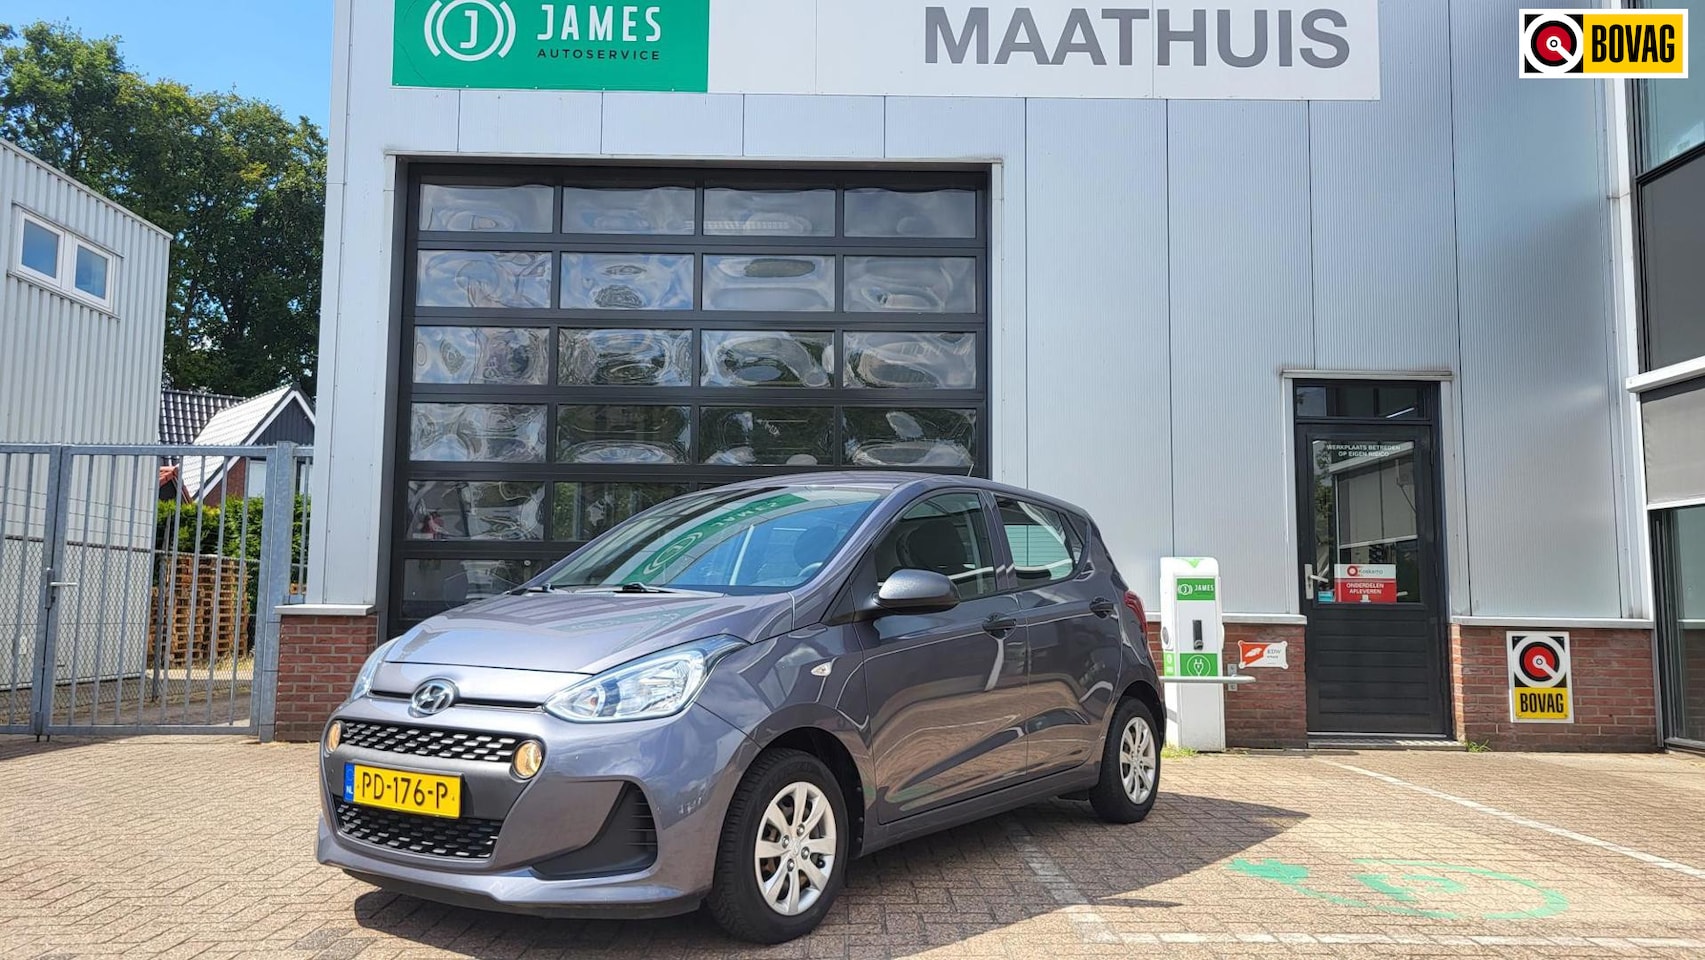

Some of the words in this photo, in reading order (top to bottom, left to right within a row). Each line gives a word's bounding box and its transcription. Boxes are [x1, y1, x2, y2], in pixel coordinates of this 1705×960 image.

[459, 9, 479, 49] J
[536, 4, 662, 43] JAMES
[924, 6, 1351, 69] MAATHUIS
[537, 48, 661, 61] AUTOSERVICE
[1519, 692, 1564, 714] BOVAG
[346, 785, 354, 795] NL
[361, 771, 449, 810] PD-176-P
